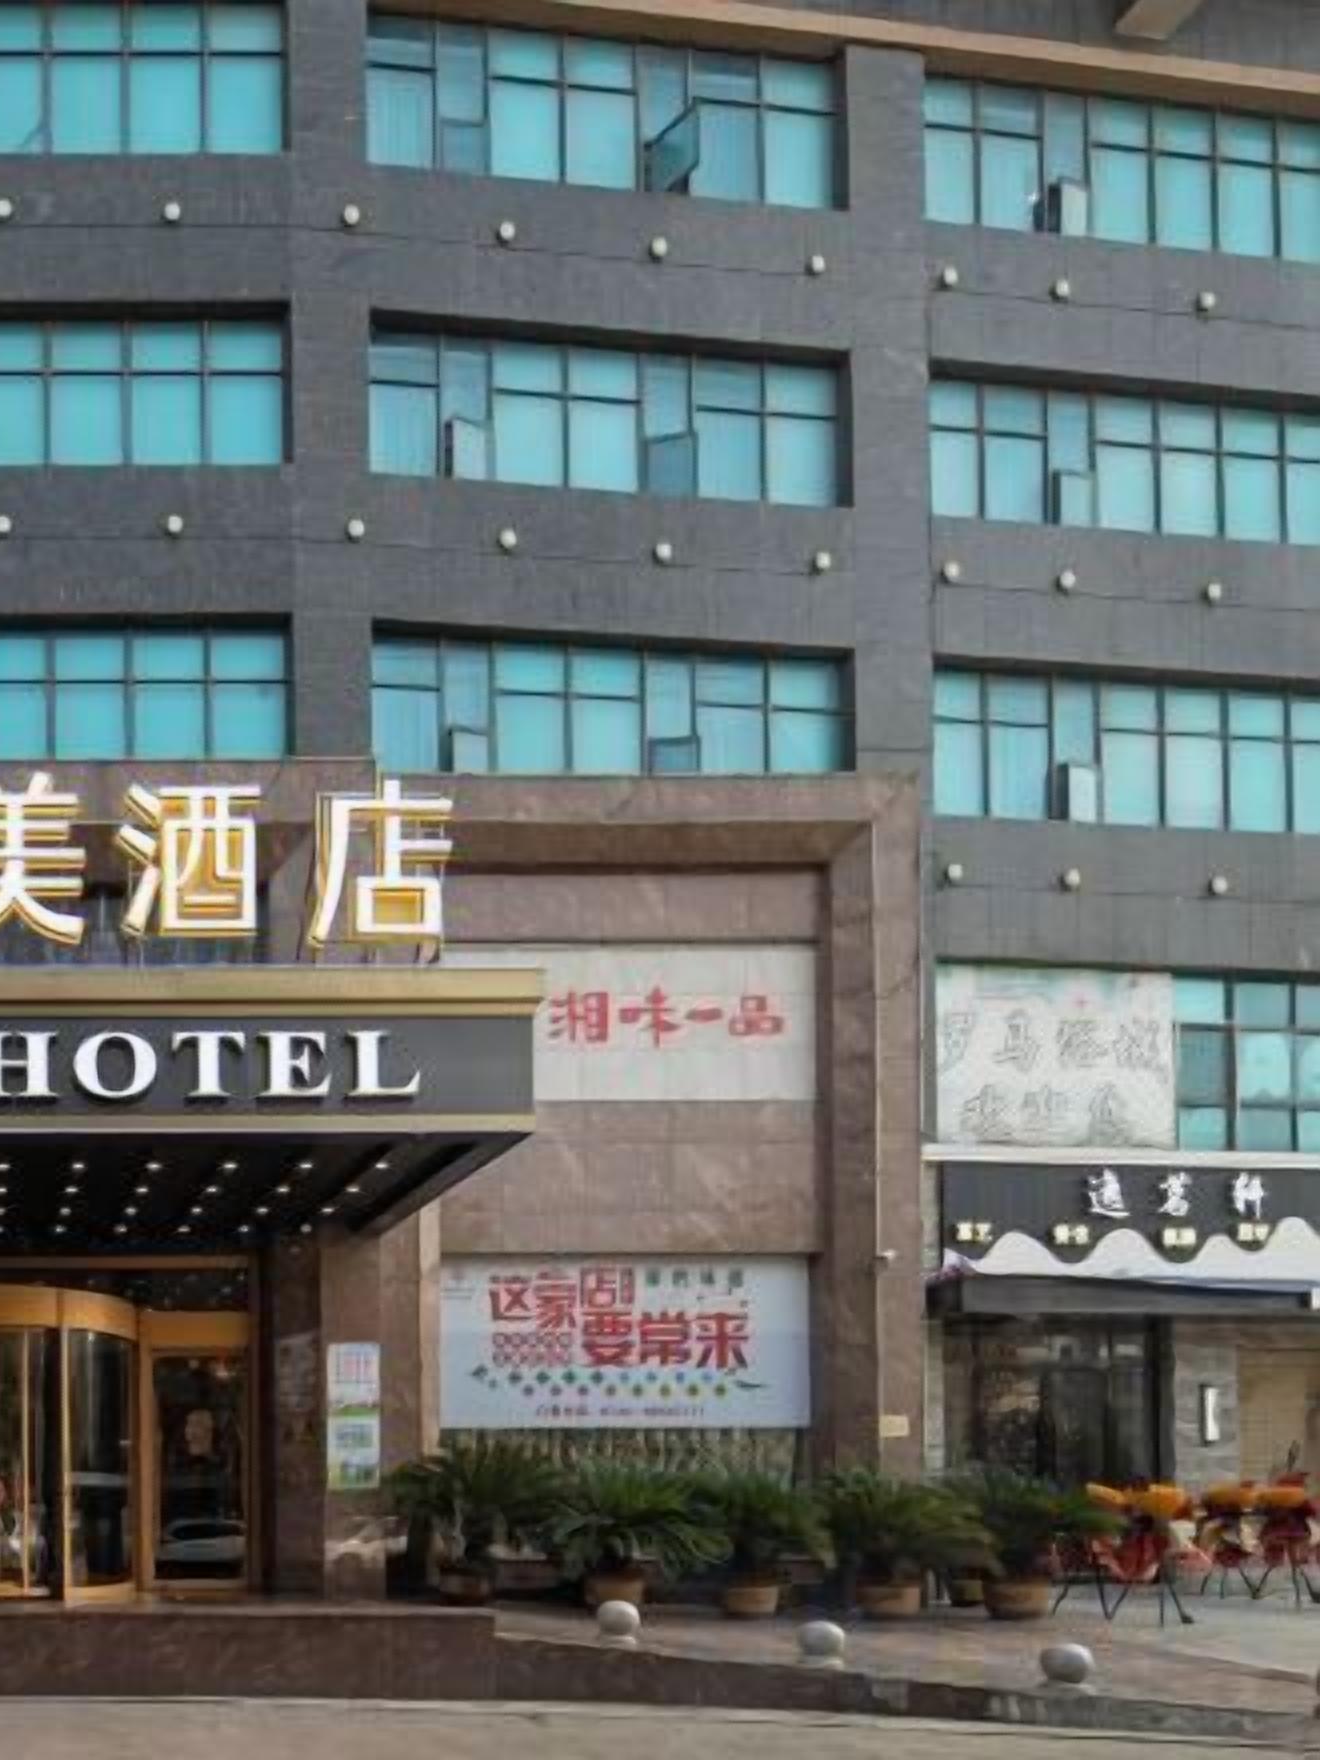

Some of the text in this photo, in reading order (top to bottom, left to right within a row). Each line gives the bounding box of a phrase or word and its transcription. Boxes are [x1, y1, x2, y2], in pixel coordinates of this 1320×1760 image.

[547, 985, 785, 1048] 湘味一品
[580, 1309, 750, 1370] 要常来
